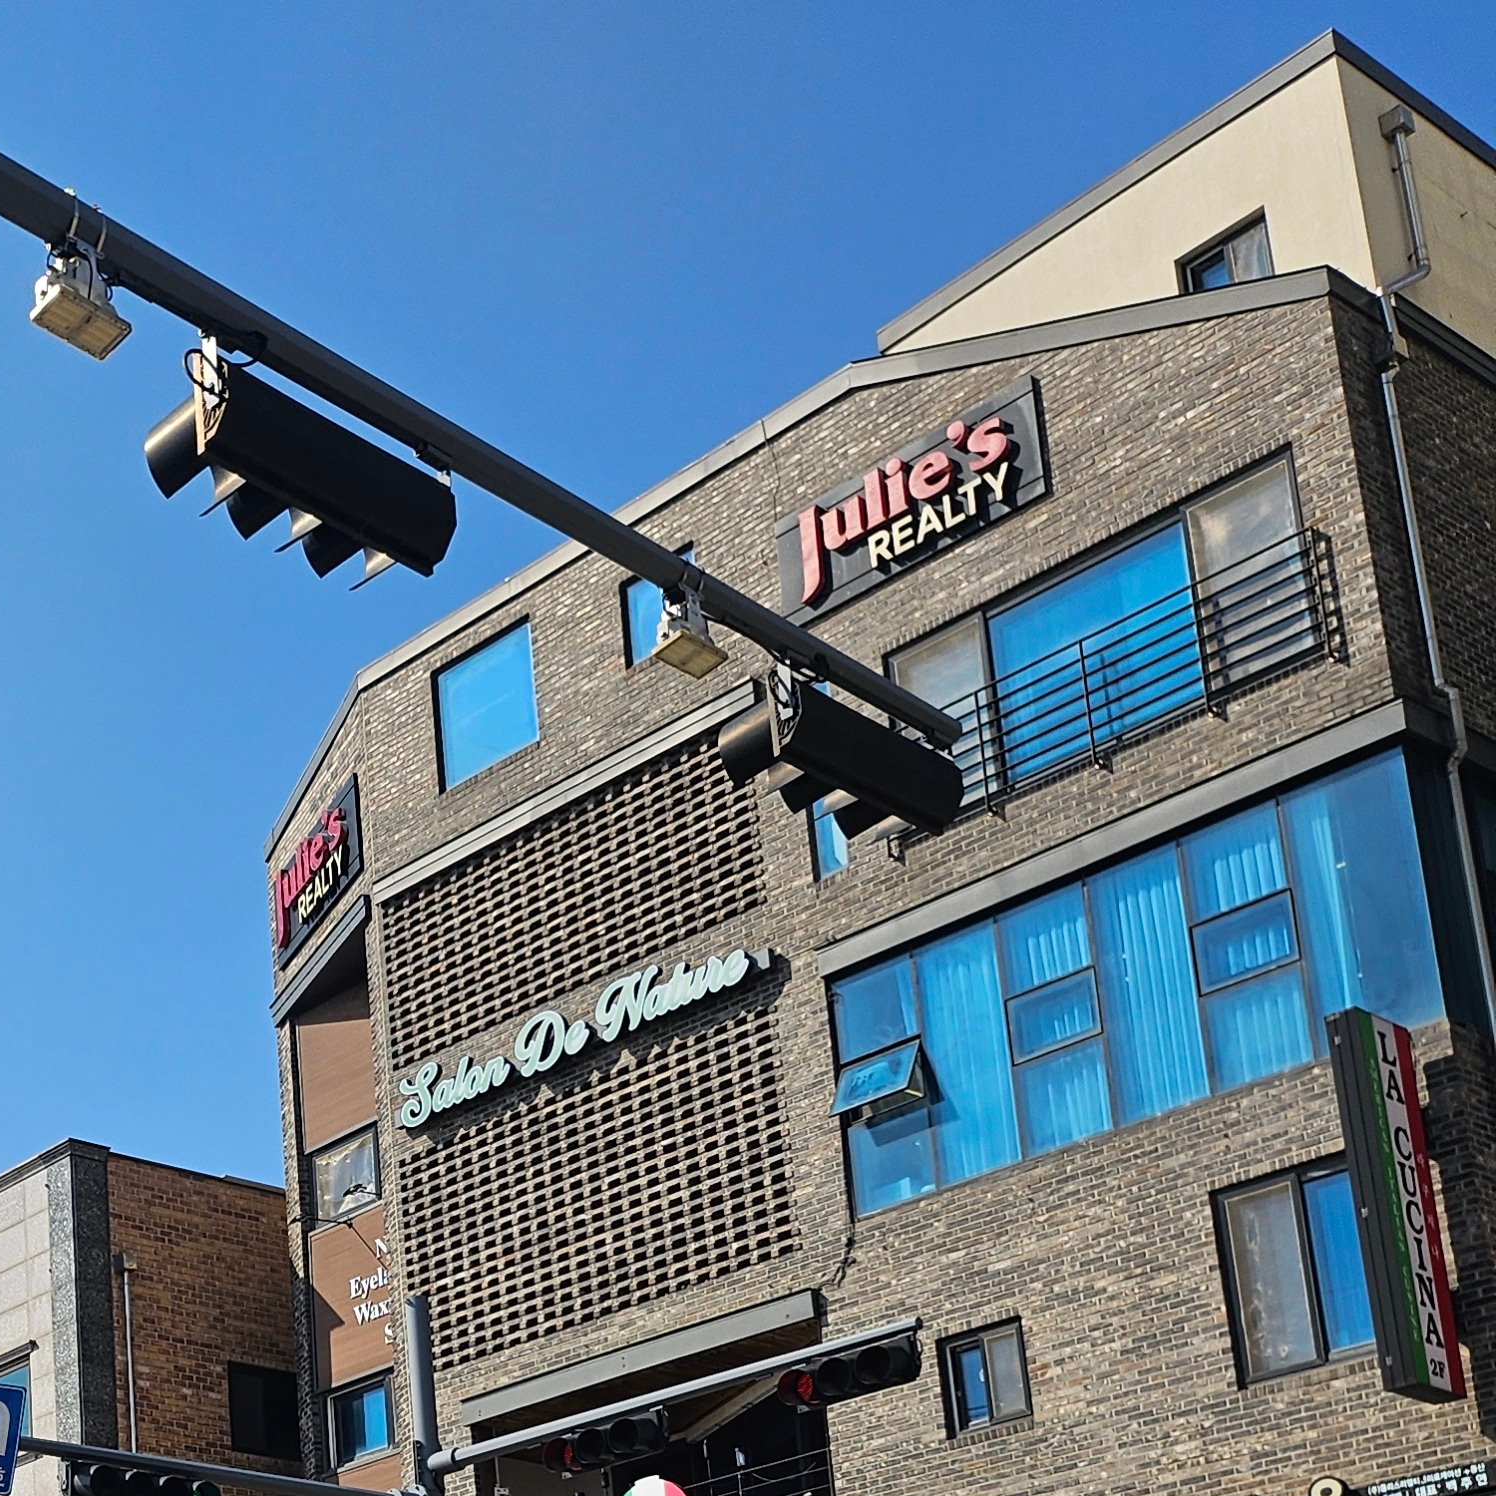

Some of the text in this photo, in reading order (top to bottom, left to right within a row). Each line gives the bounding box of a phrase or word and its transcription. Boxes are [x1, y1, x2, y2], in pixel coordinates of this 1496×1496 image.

[797, 417, 1010, 603] Julie's
[868, 462, 1009, 568] REALTY
[275, 807, 347, 948] Julie's
[298, 844, 343, 924] REALTY
[400, 948, 751, 1128] Salon De Nature
[1377, 1031, 1446, 1378] LA CUCINA 2F
